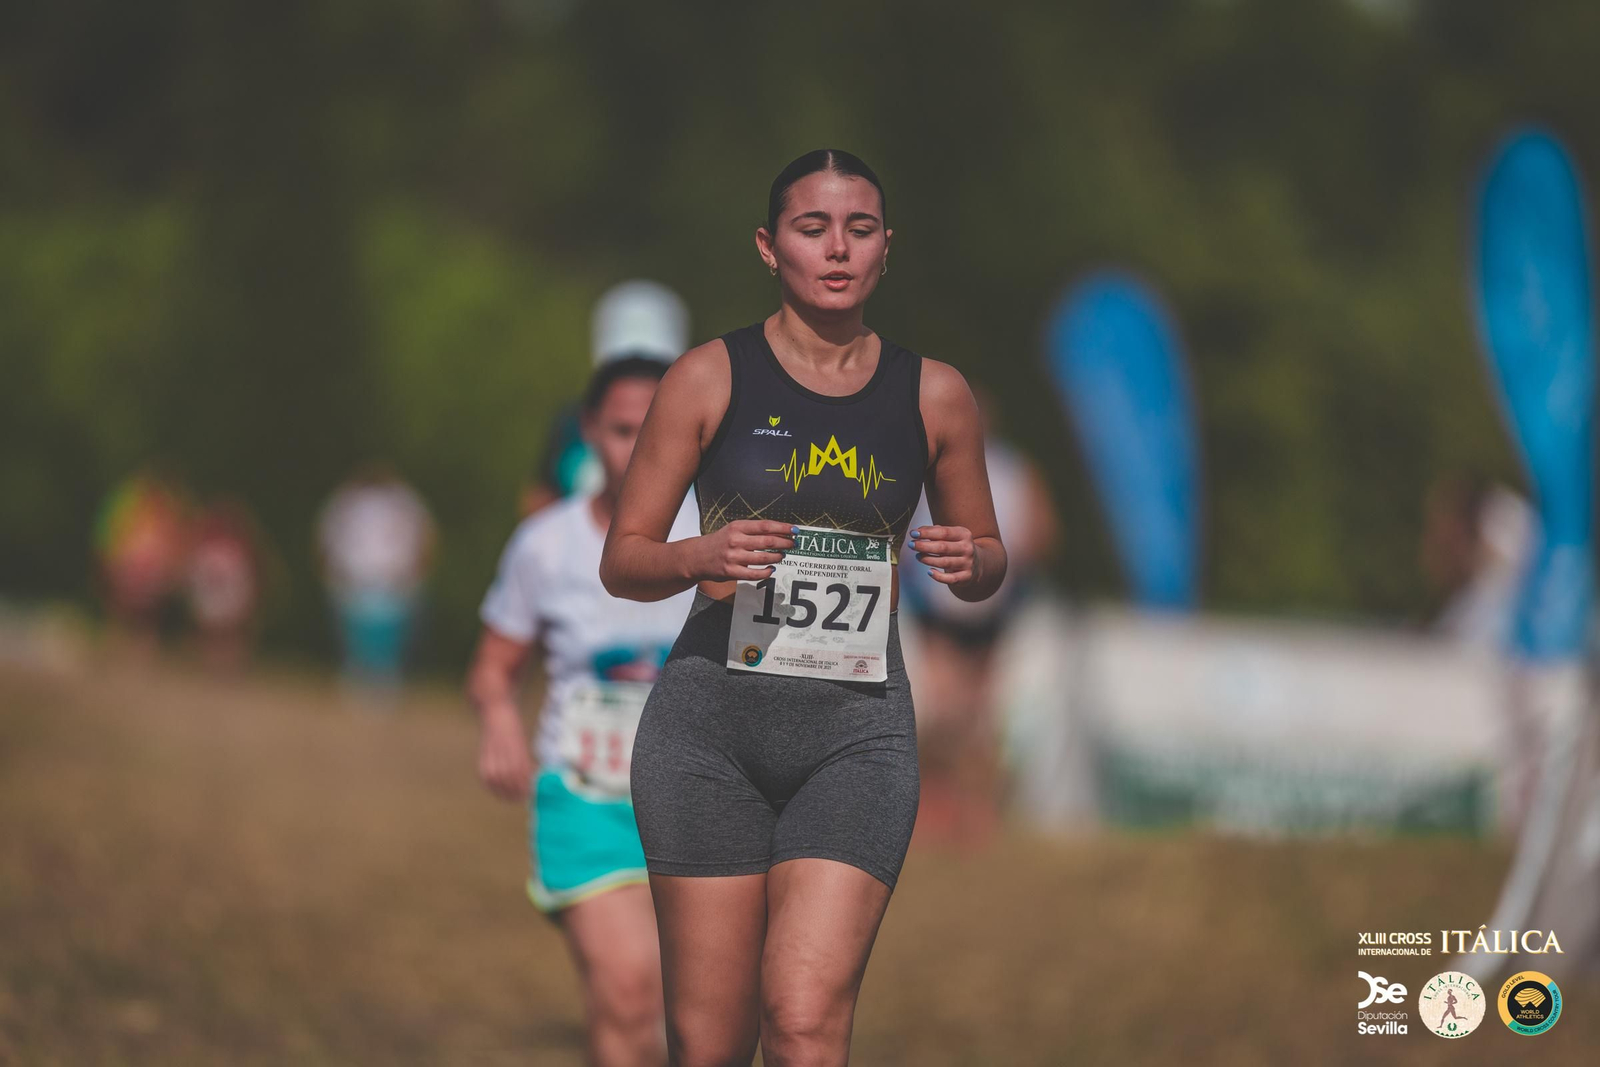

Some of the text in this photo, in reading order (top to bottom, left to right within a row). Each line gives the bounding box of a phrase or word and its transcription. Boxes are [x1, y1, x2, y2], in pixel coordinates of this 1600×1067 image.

[752, 428, 792, 437] SPALL
[792, 533, 857, 554] TÁLICA
[799, 561, 836, 571] GUERRERO
[797, 569, 848, 579] INDEPENDIENTE
[752, 577, 881, 632] 1527
